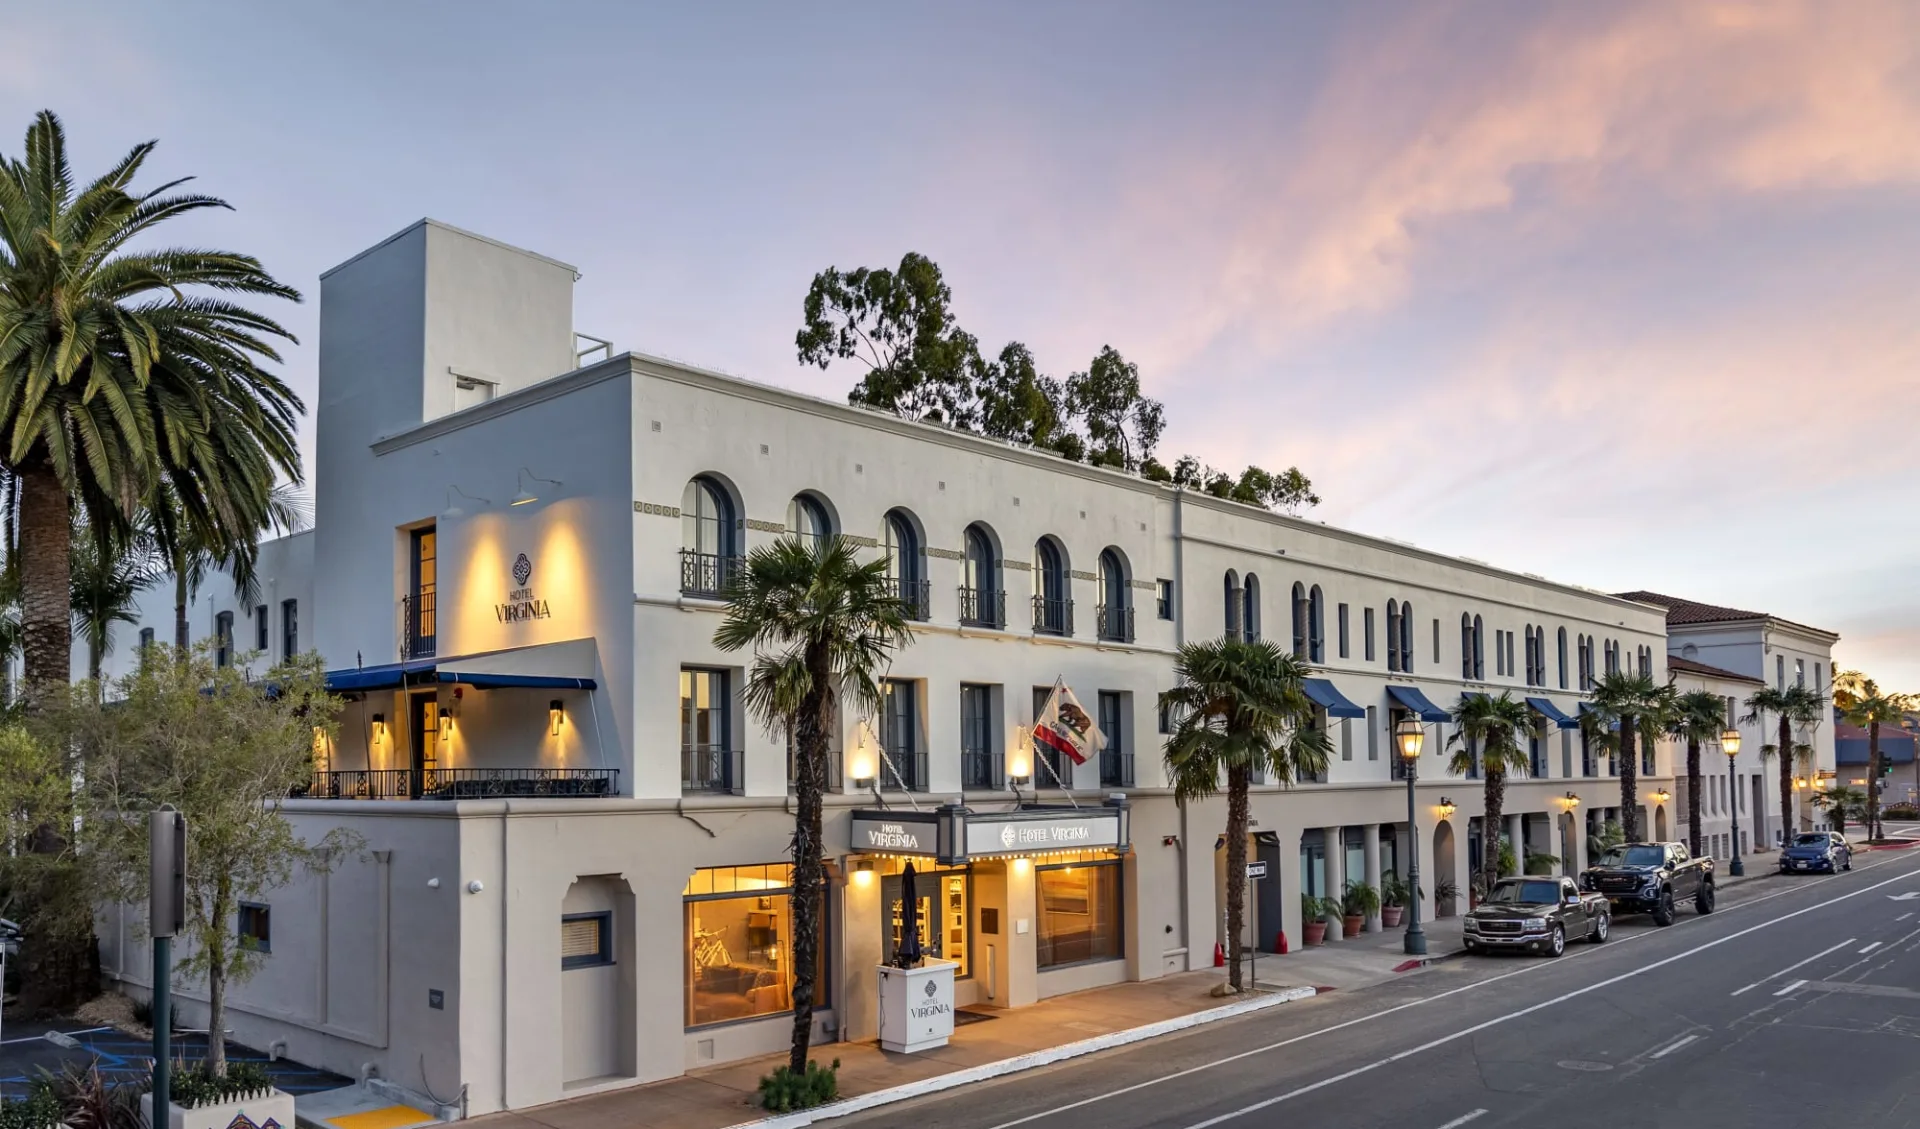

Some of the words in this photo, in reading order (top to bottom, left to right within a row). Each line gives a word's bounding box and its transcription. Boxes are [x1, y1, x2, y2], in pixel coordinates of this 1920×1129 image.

[509, 588, 534, 601] HOTEL
[495, 600, 550, 623] VIRGINIA
[882, 824, 904, 834] HOTEL
[1019, 828, 1049, 843] HOTEL
[1051, 825, 1089, 841] VIRGINIA
[868, 830, 919, 848] VIRGINIA
[922, 998, 938, 1006] HOTEL
[911, 1004, 950, 1018] VIRGINIA
